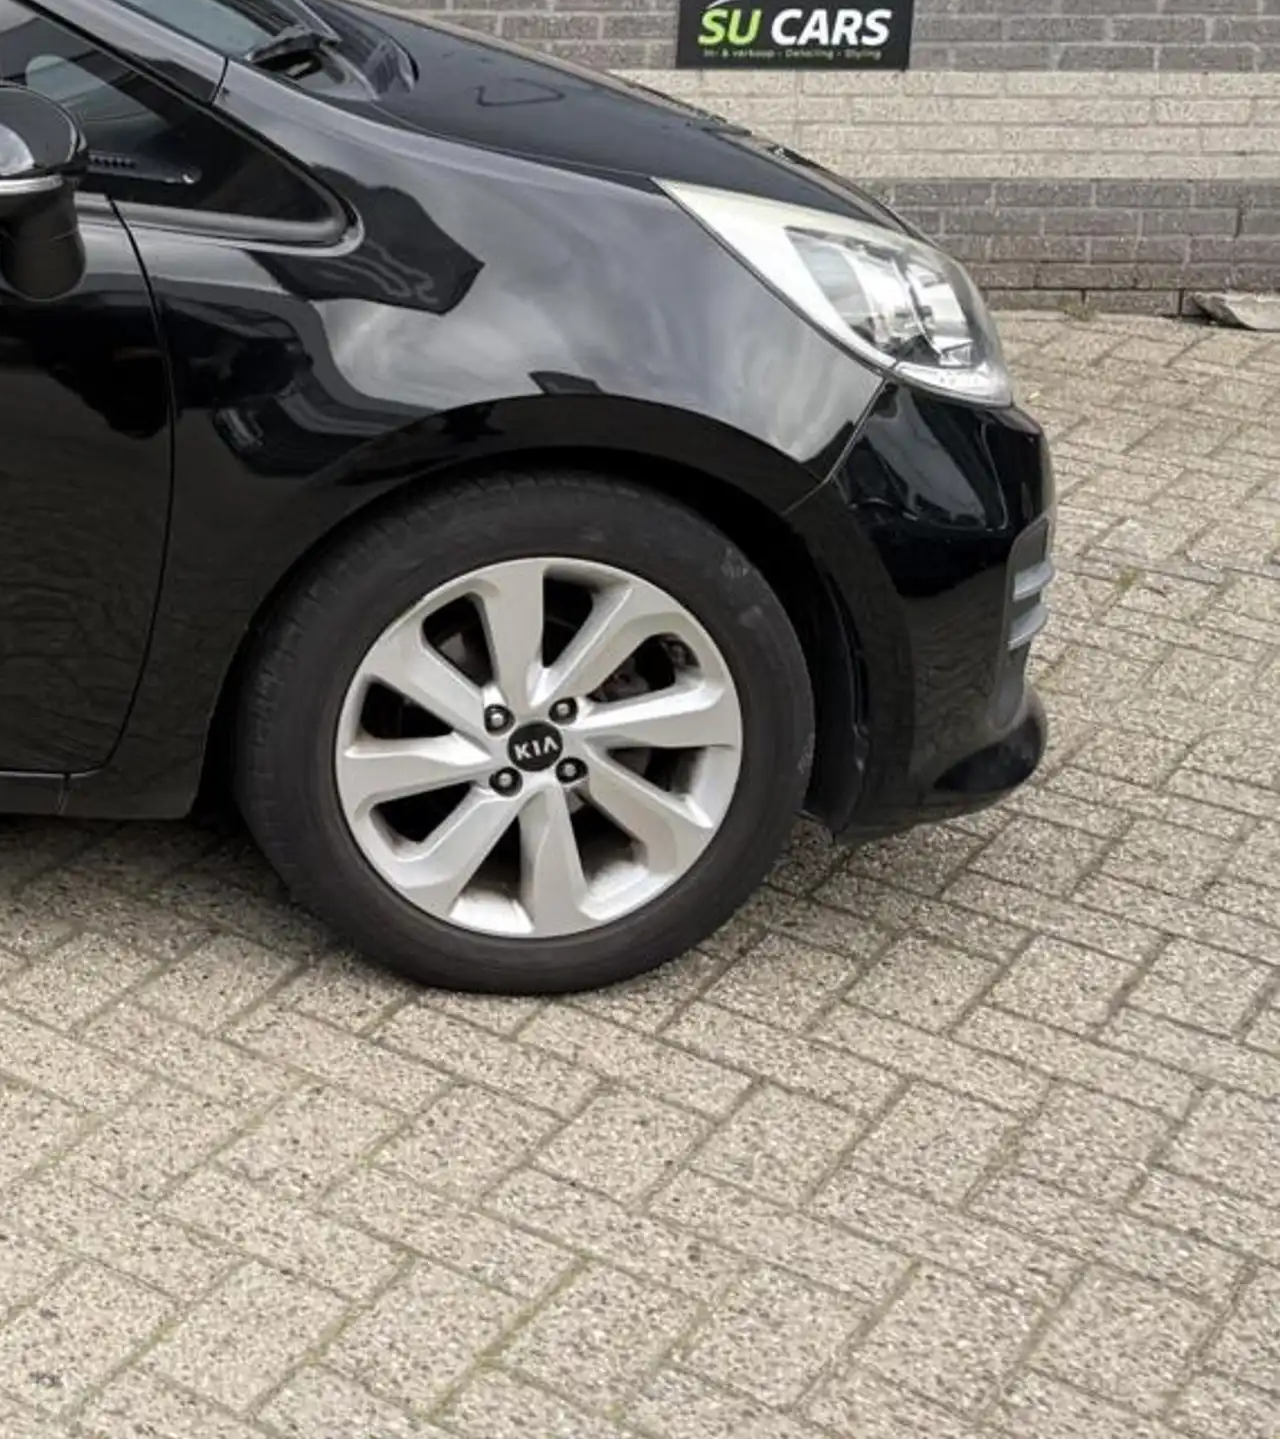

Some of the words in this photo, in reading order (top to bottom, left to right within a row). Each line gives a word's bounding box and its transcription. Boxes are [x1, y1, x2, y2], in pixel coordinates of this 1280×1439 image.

[697, 8, 763, 47] SU
[770, 7, 893, 47] CARS
[513, 735, 560, 762] KIA
